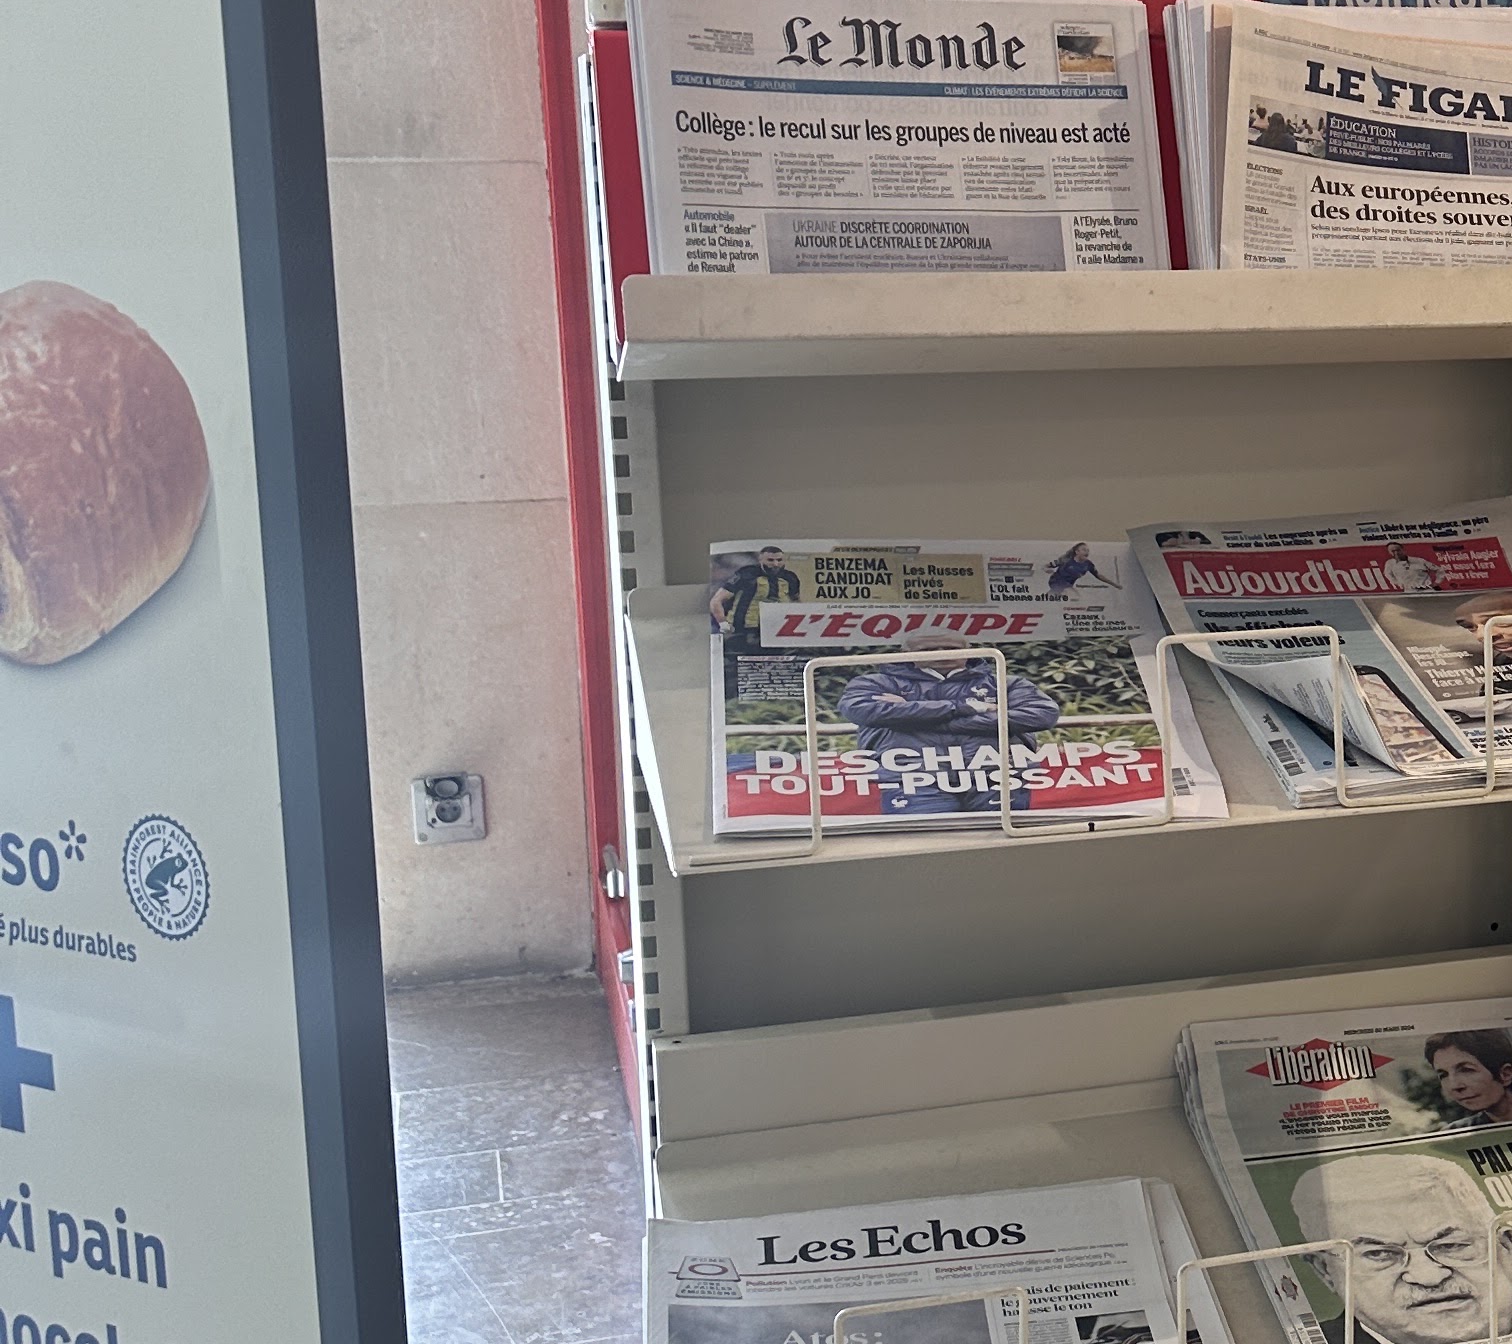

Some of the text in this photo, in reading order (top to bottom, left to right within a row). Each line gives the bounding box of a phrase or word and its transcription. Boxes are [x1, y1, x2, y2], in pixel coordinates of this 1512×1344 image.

[777, 15, 1028, 72] Le Monde
[1304, 59, 1366, 103] LE
[759, 116, 776, 140] le
[780, 117, 828, 142] recul
[832, 122, 859, 142] sur
[864, 118, 892, 142] les
[896, 124, 969, 146] groupes
[973, 121, 995, 143] de
[1000, 121, 1058, 144] niveau
[1062, 125, 1088, 144] est
[1093, 122, 1130, 144] acté
[1310, 175, 1356, 198] Aux
[1310, 199, 1358, 221] des
[1362, 202, 1437, 225] droites
[1182, 560, 1385, 597] Aujourd'hui
[775, 611, 1044, 637] L'ÉQUIPE
[755, 741, 1142, 774] DESCHAMPS
[734, 762, 1159, 796] TOUT-PUISSANT
[9, 920, 137, 963] plus durables
[1266, 1042, 1376, 1088] Libération
[49, 1207, 168, 1289] pain
[757, 1219, 1026, 1267] Les Echos
